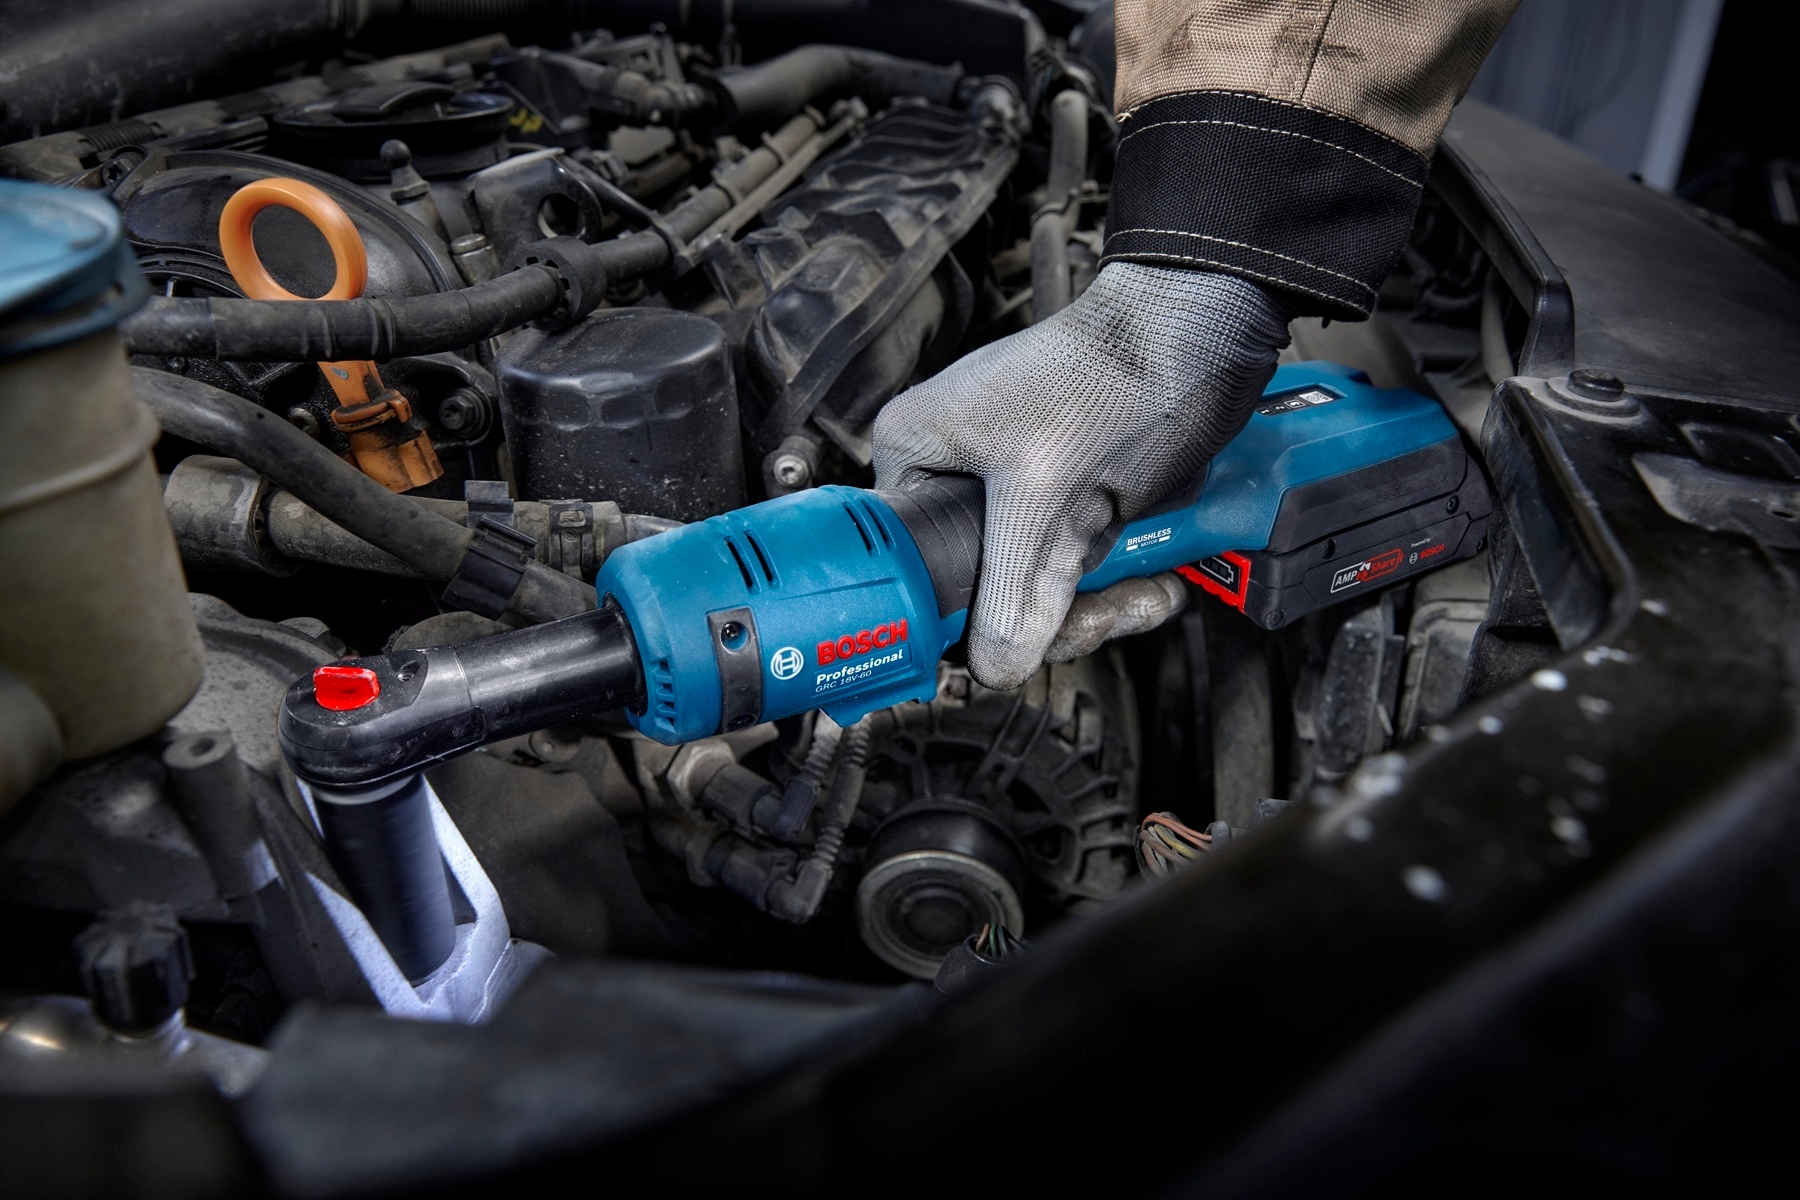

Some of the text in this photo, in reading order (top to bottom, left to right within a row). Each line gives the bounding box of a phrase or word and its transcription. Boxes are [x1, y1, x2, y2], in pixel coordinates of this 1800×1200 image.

[1127, 528, 1172, 546] BRUSHLESS
[1140, 539, 1158, 547] MOTOR
[1410, 538, 1426, 548] Powered
[1420, 543, 1445, 559] BOSCH
[1335, 558, 1396, 587] AMP Share
[817, 619, 908, 666] BOSCH
[816, 649, 903, 685] Professional
[815, 670, 872, 693] GRC 18V-60
